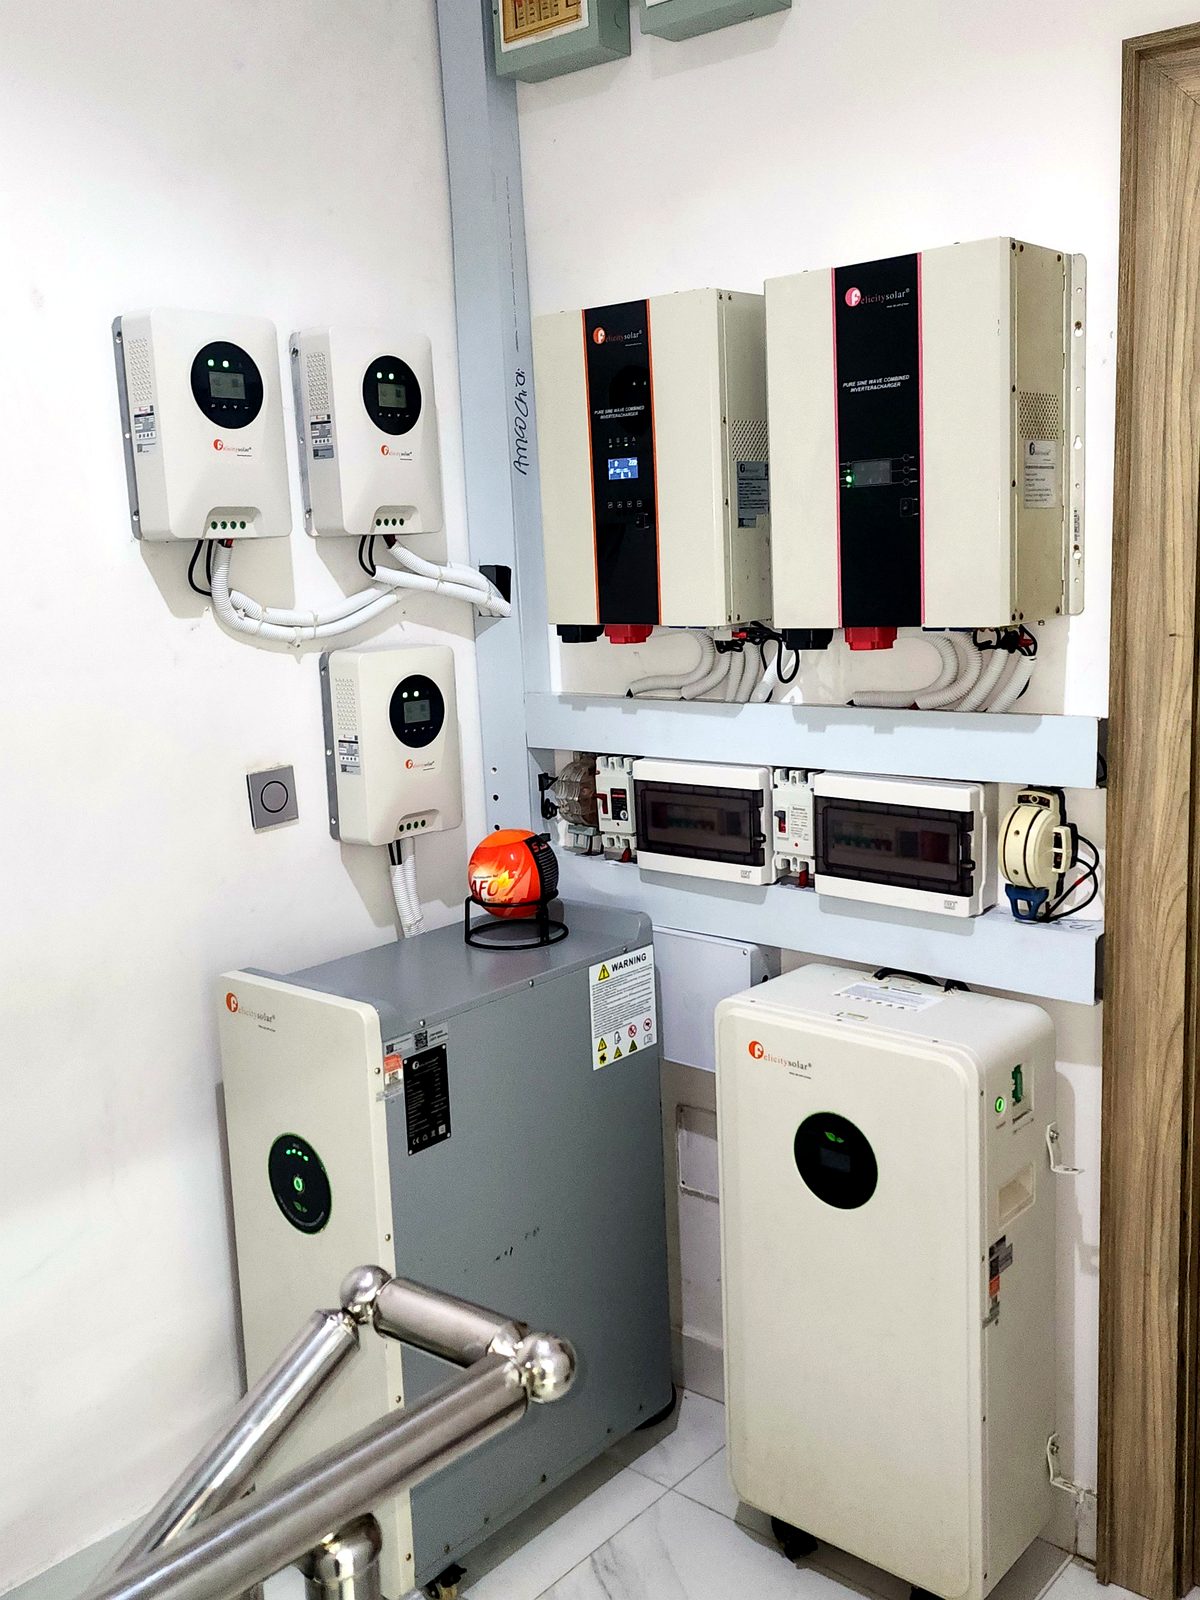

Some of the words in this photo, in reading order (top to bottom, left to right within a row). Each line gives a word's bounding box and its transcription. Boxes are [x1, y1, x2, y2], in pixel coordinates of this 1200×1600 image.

[883, 374, 910, 383] COMBINED
[471, 879, 499, 899] AFO
[611, 952, 647, 972] WARNING
